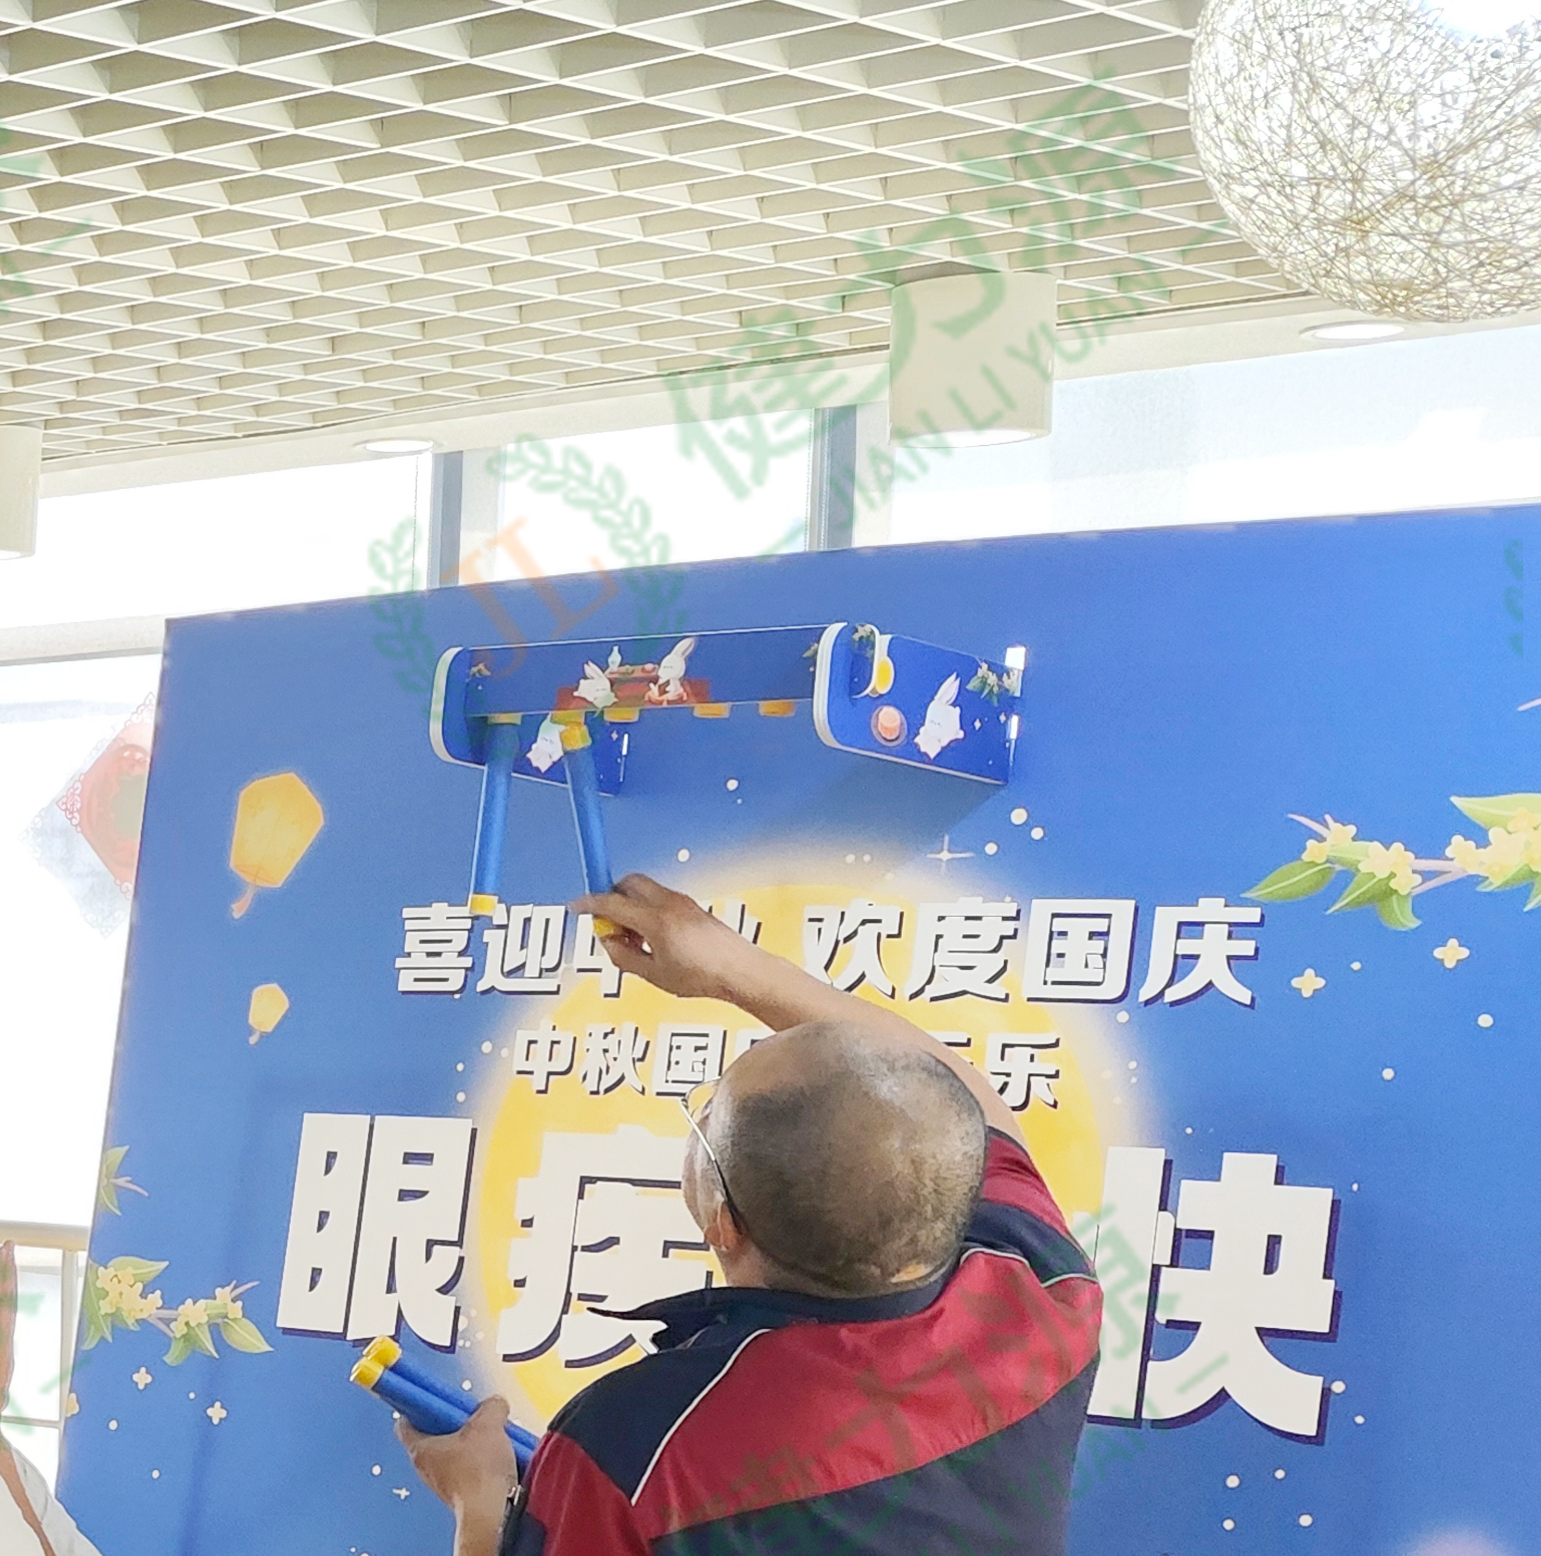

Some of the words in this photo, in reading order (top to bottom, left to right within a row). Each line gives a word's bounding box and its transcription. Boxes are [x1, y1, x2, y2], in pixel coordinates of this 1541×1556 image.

[803, 896, 1263, 1008] 欢度国庆
[512, 1022, 1061, 1113] 中秋国乐
[277, 1110, 1341, 1441] 眼疾快
